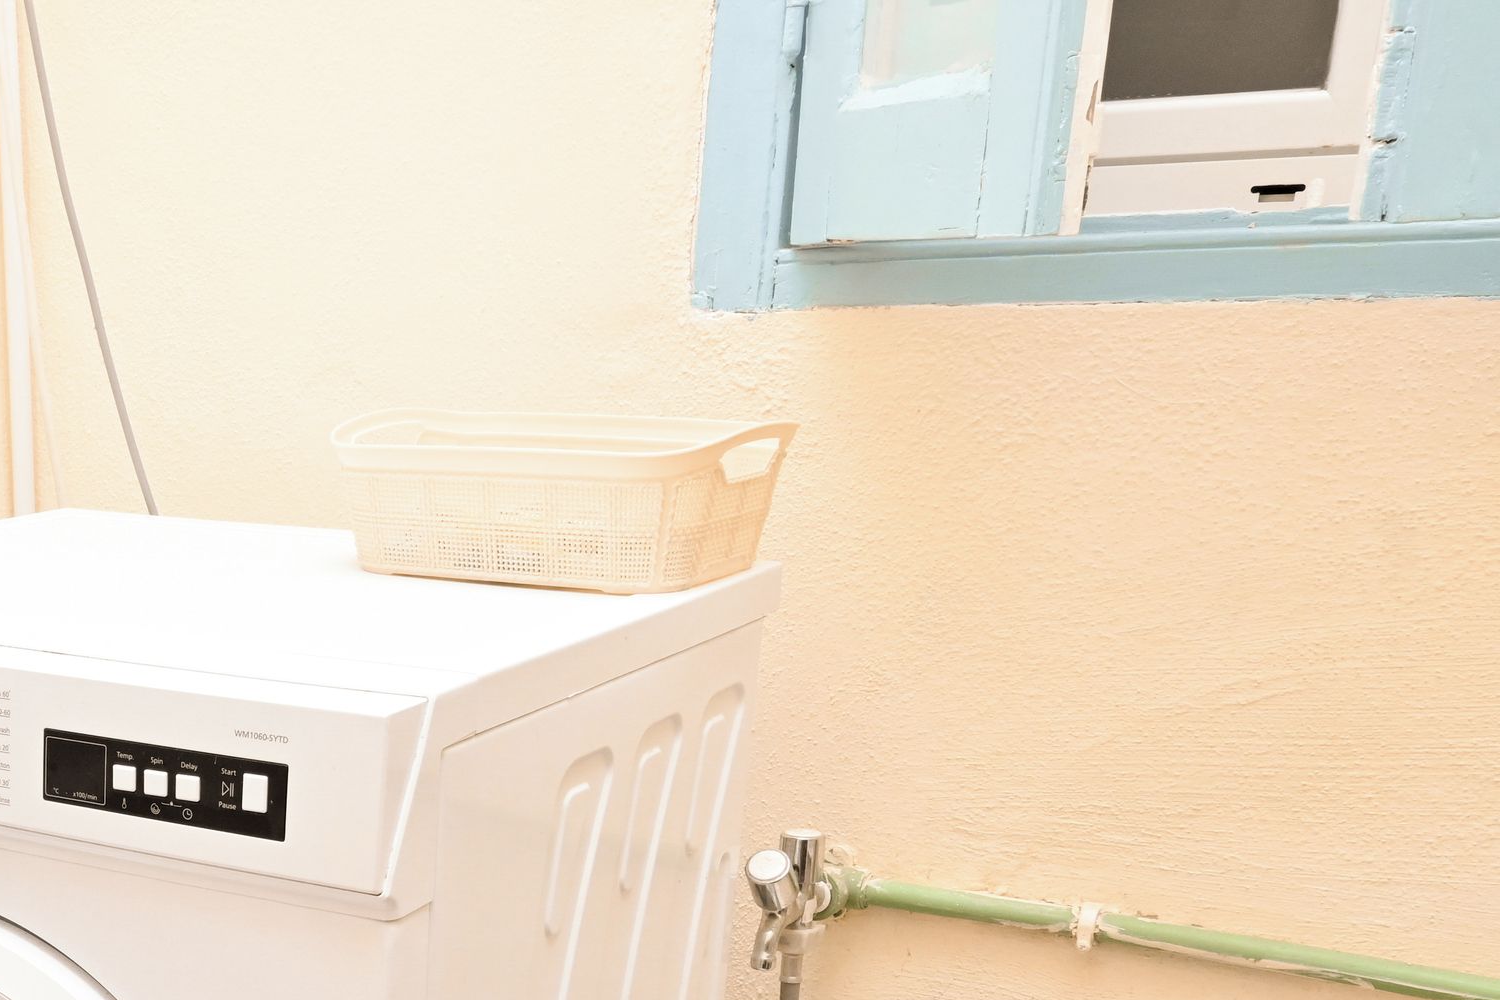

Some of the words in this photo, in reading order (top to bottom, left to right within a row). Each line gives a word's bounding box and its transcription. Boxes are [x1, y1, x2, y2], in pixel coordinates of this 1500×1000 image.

[116, 751, 134, 761] Temp.
[150, 756, 164, 766] Spin
[180, 761, 198, 772] Delay
[221, 767, 237, 777] Start
[218, 800, 237, 811] Pause
